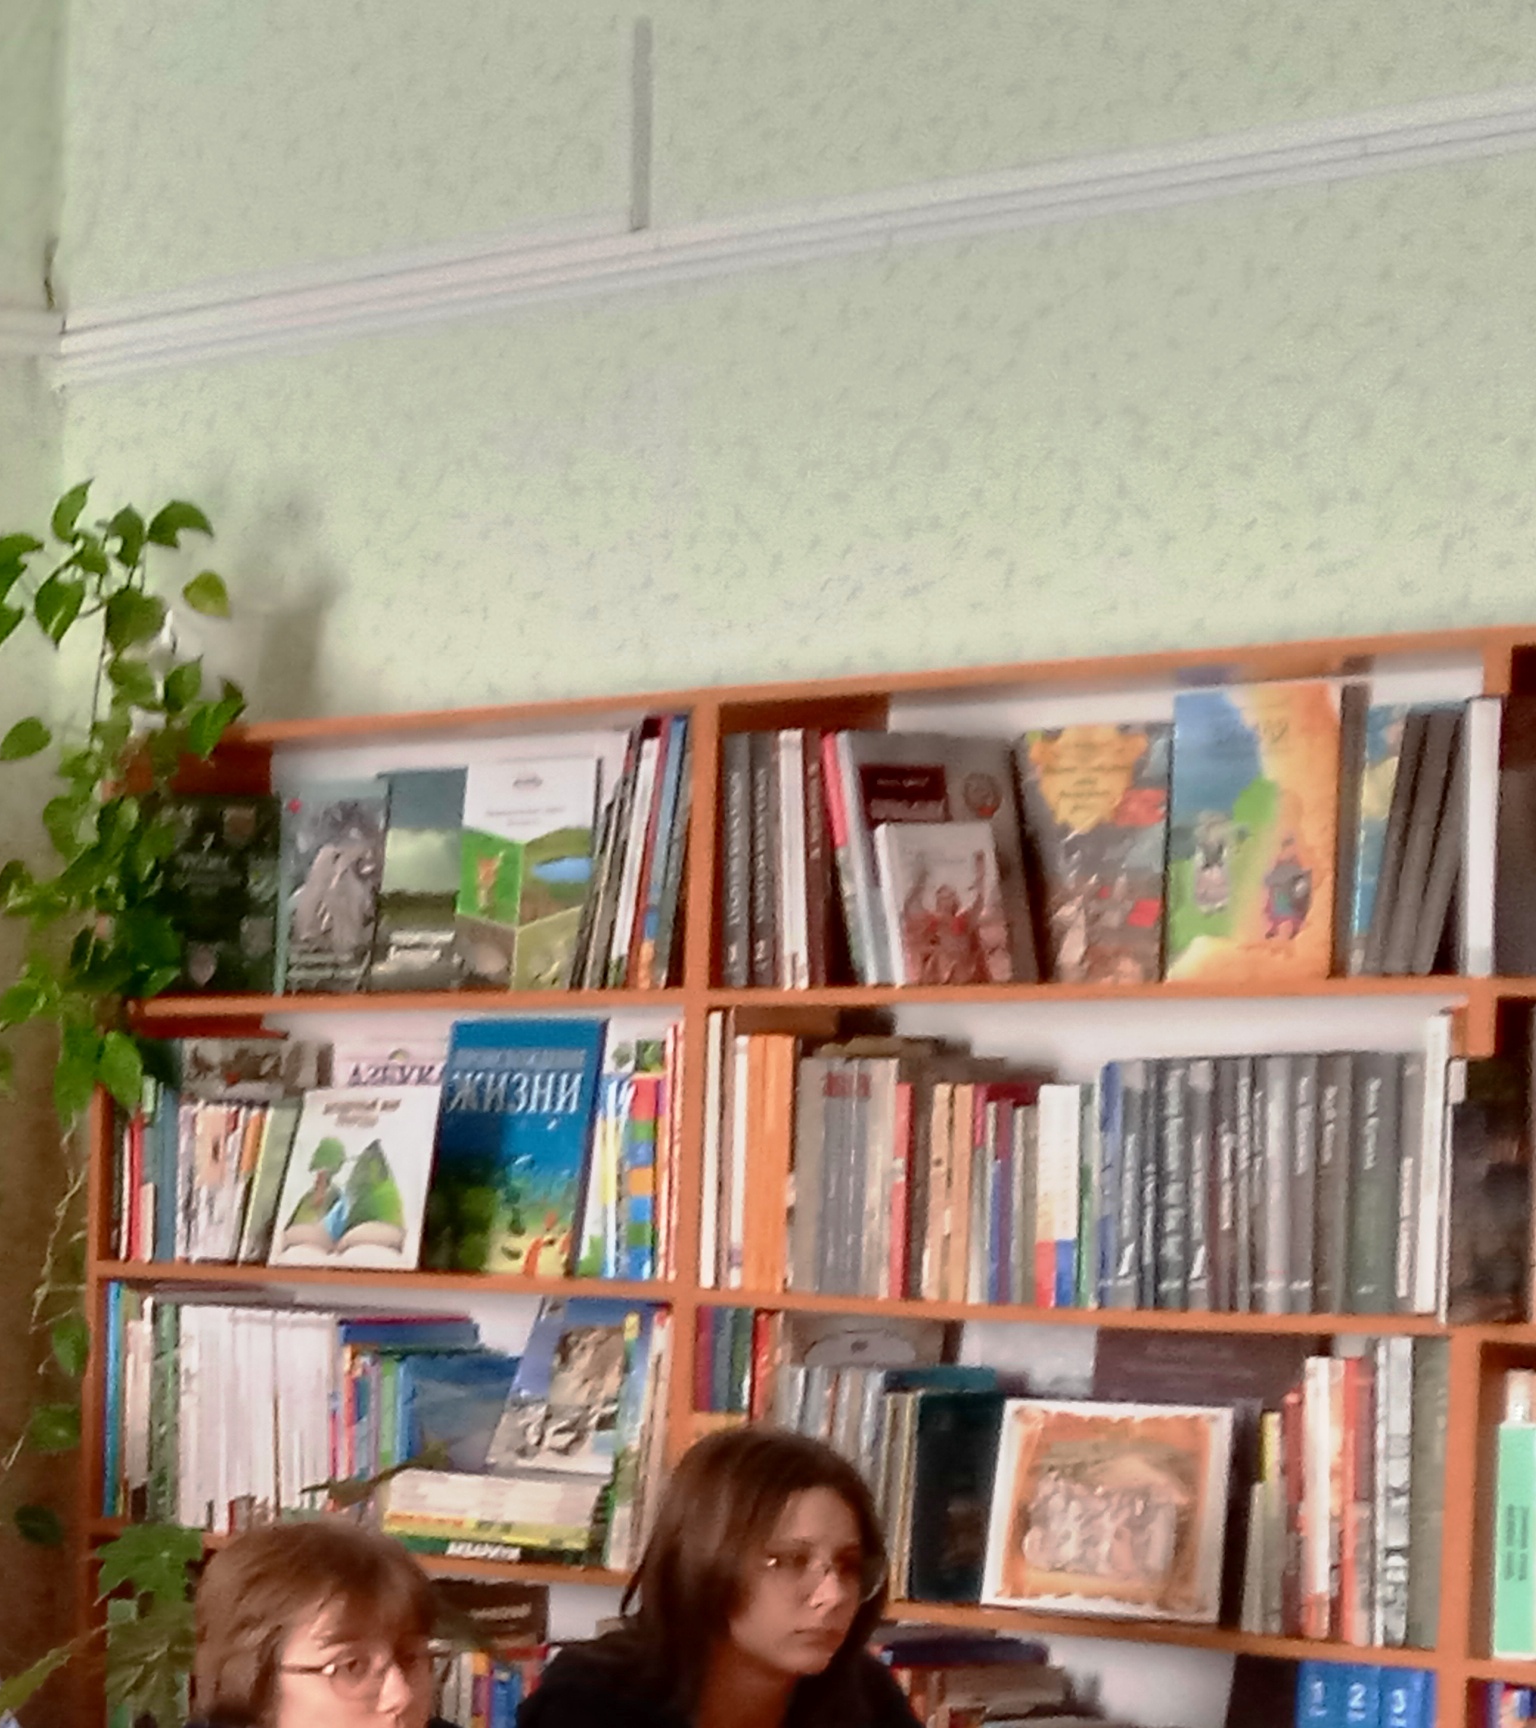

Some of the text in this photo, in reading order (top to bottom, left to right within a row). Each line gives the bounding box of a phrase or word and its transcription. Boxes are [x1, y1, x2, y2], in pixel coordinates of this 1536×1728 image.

[446, 1069, 586, 1116] ЖИЗНИ
[1347, 1682, 1368, 1710] 2
[1390, 1687, 1408, 1714] 3
